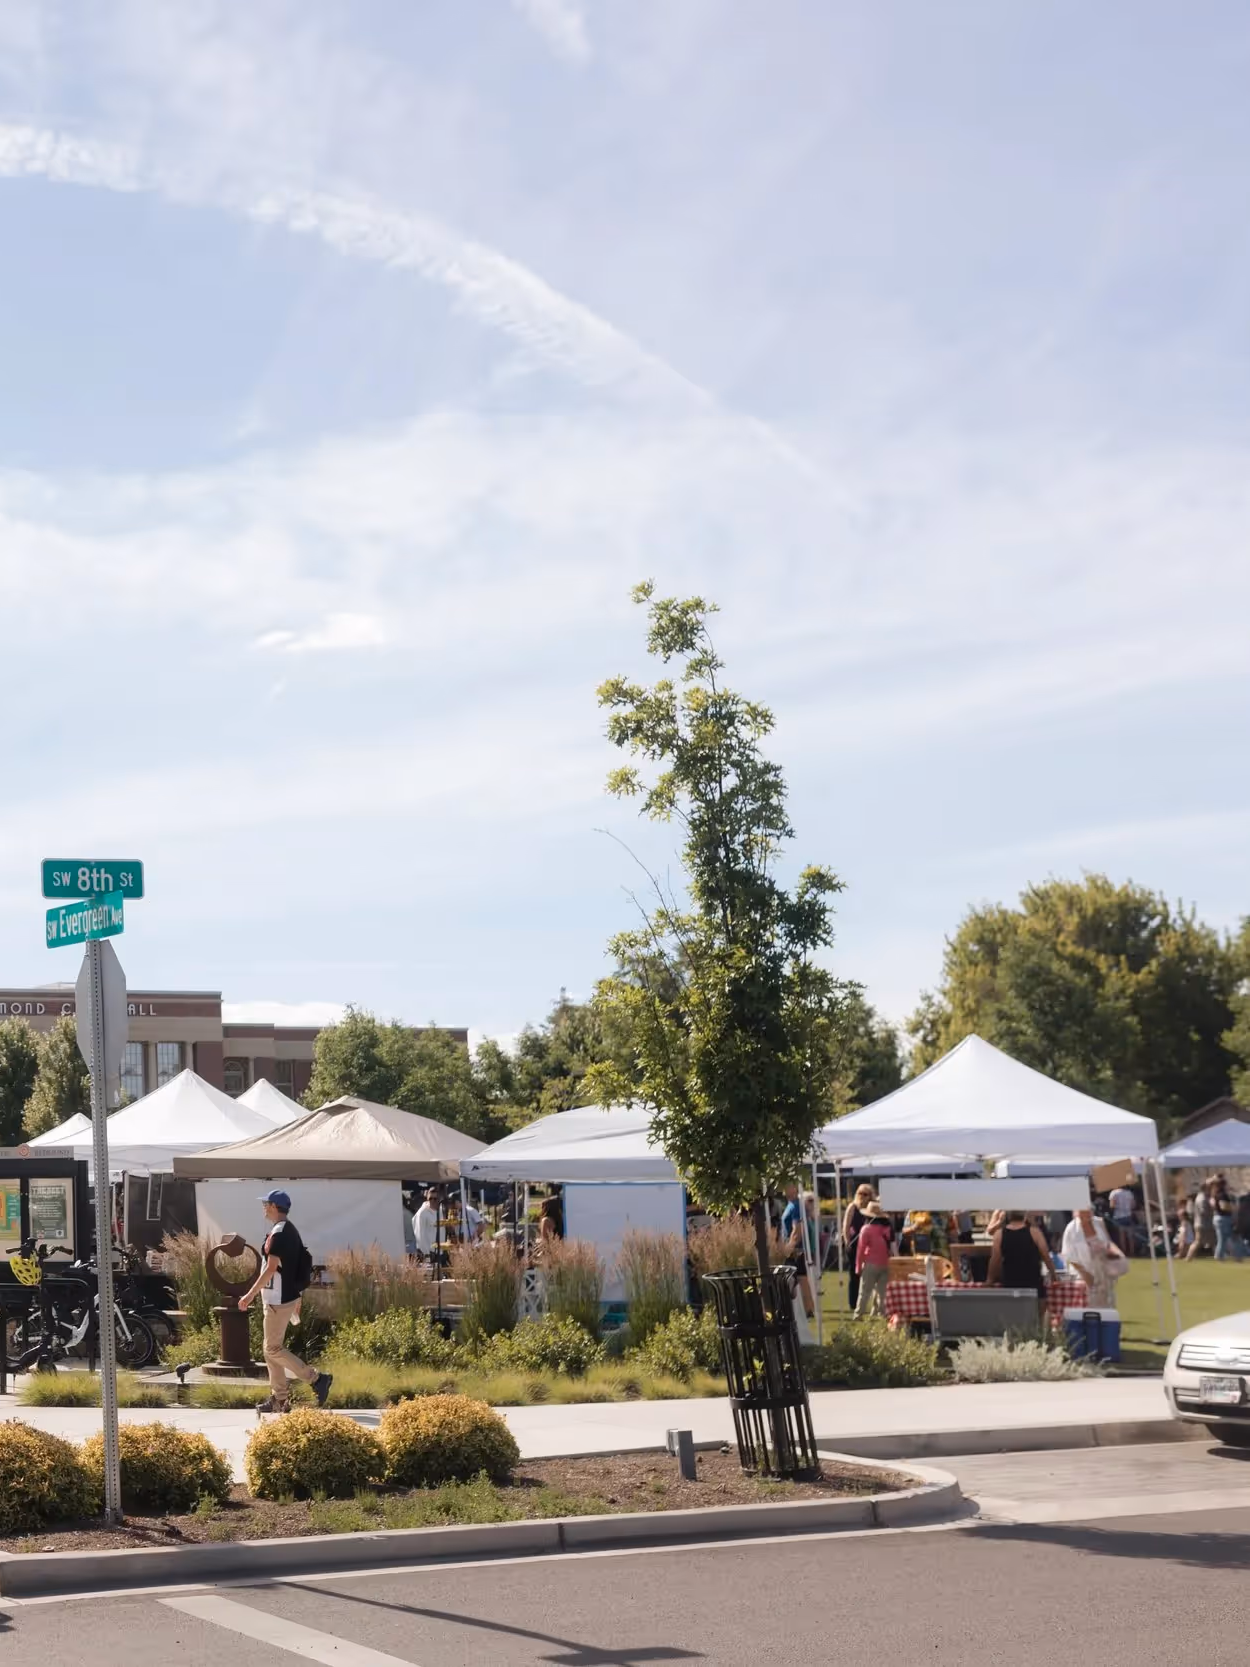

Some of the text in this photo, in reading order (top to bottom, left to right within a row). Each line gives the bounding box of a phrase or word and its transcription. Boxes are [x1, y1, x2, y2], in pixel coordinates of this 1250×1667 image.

[52, 867, 134, 891] SW 8th St
[47, 905, 123, 940] SW Evergreen Ave
[127, 1003, 157, 1016] ALL
